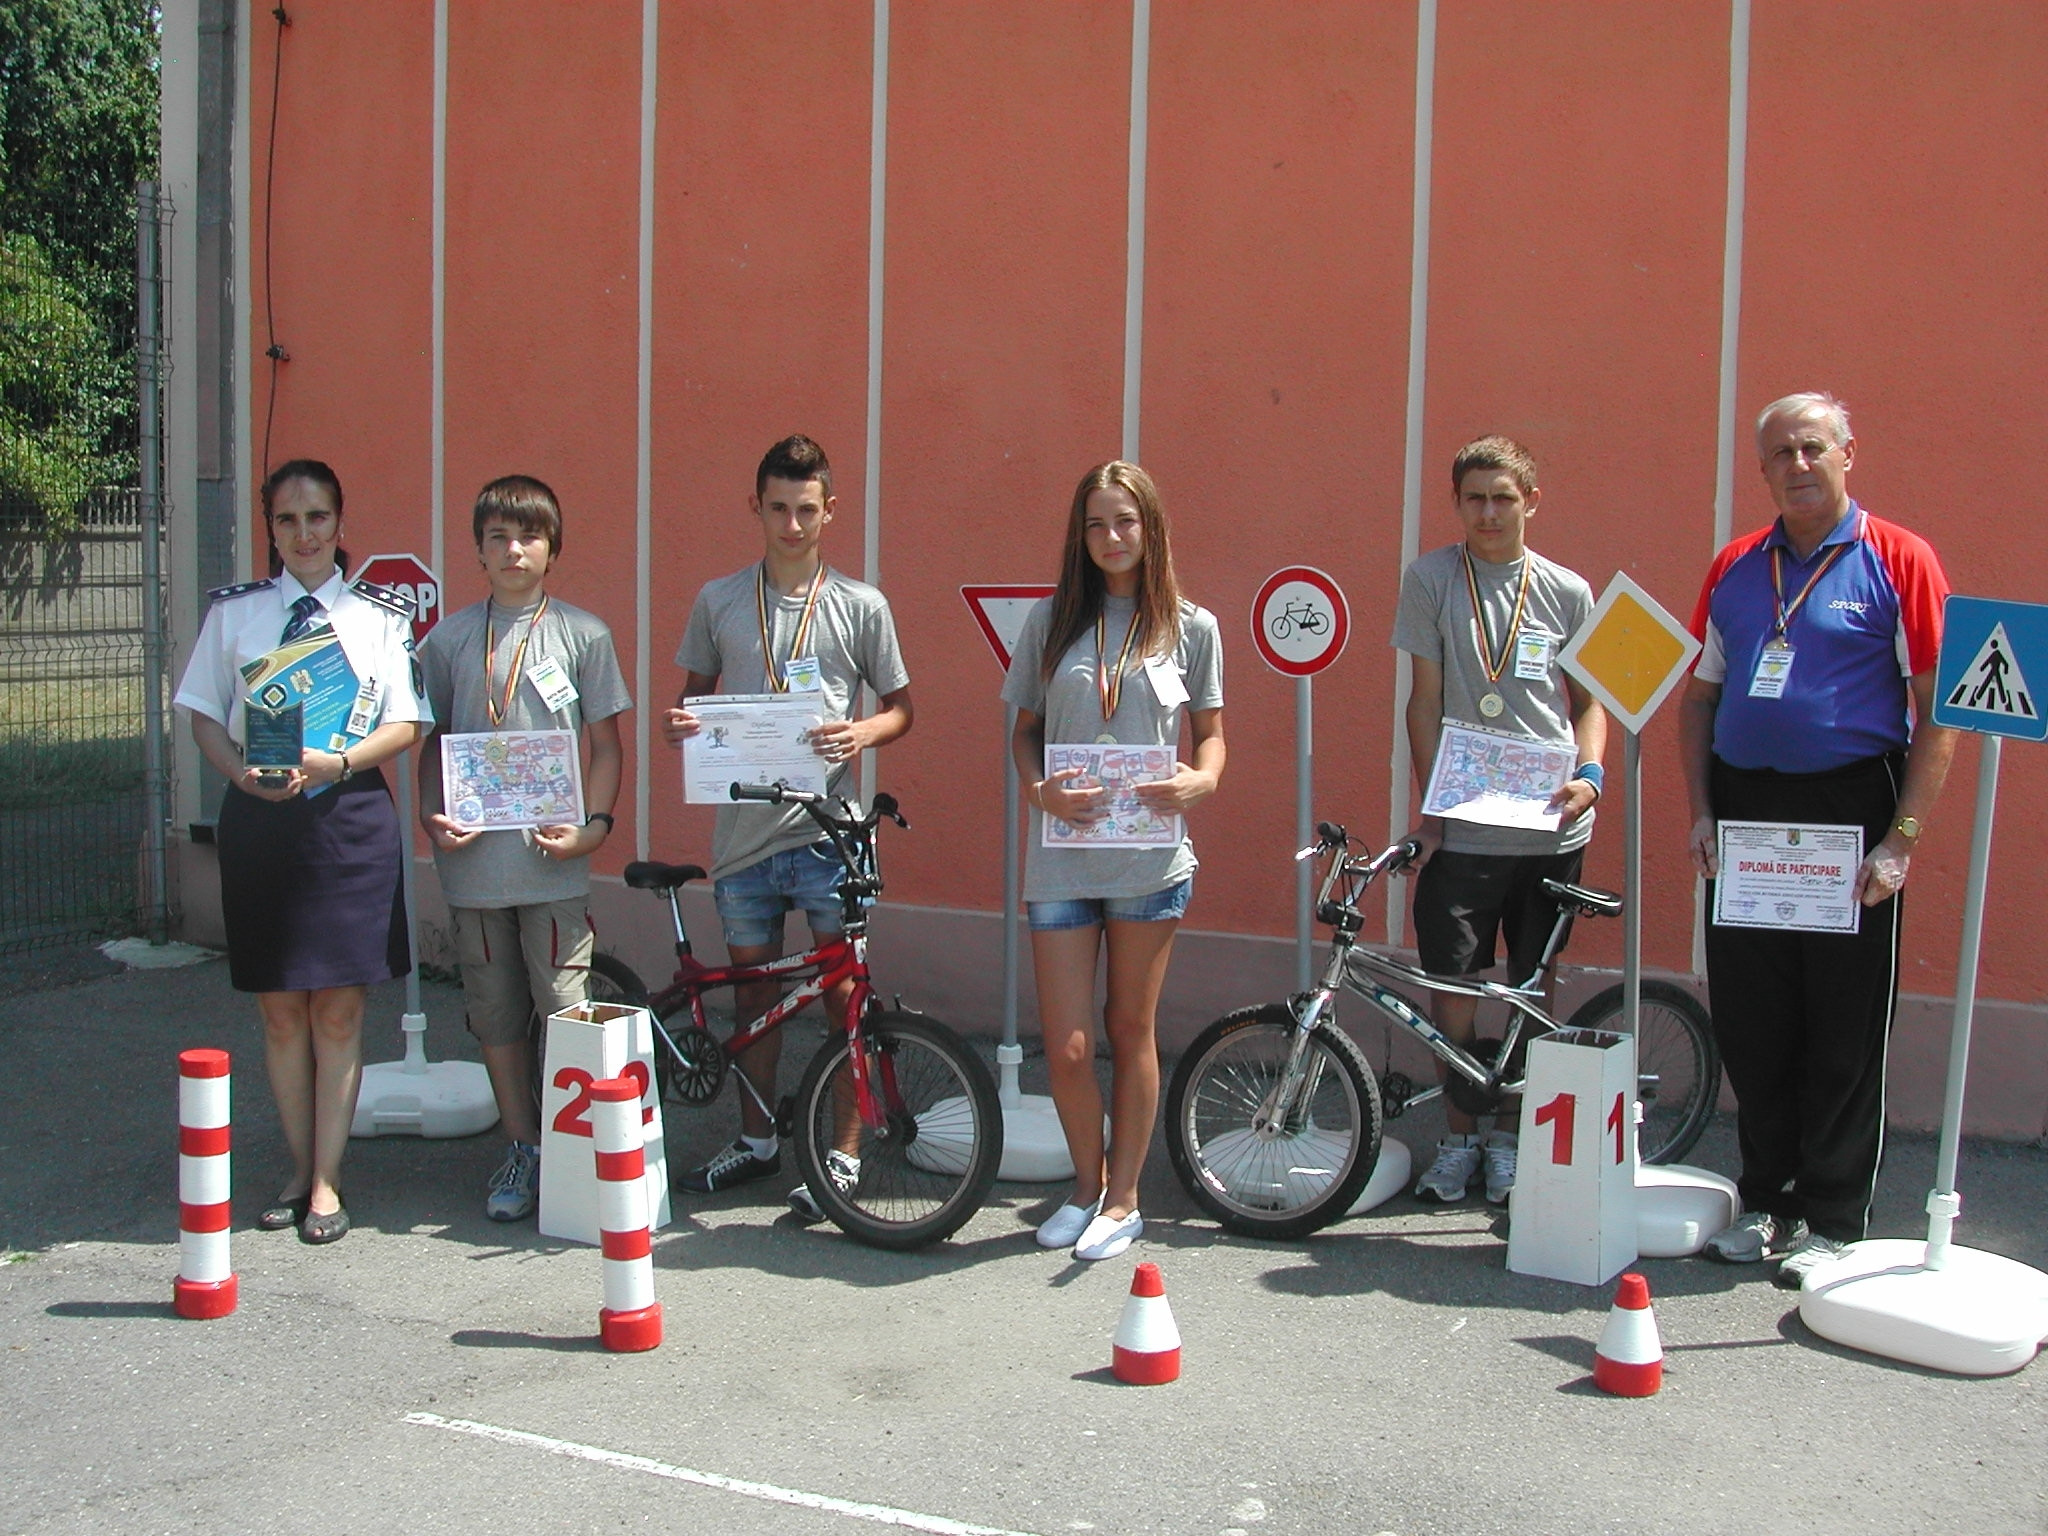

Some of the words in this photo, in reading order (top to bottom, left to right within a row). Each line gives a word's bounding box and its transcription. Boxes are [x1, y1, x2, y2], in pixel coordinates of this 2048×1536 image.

[1828, 599, 1871, 614] SPORT
[1738, 860, 1775, 874] DIPLOMĂ
[1776, 863, 1787, 875] DE
[1788, 864, 1842, 877] PARTICIPARE
[552, 1066, 594, 1138] 2
[1535, 1092, 1576, 1166] 1
[1606, 1091, 1625, 1166] 1
